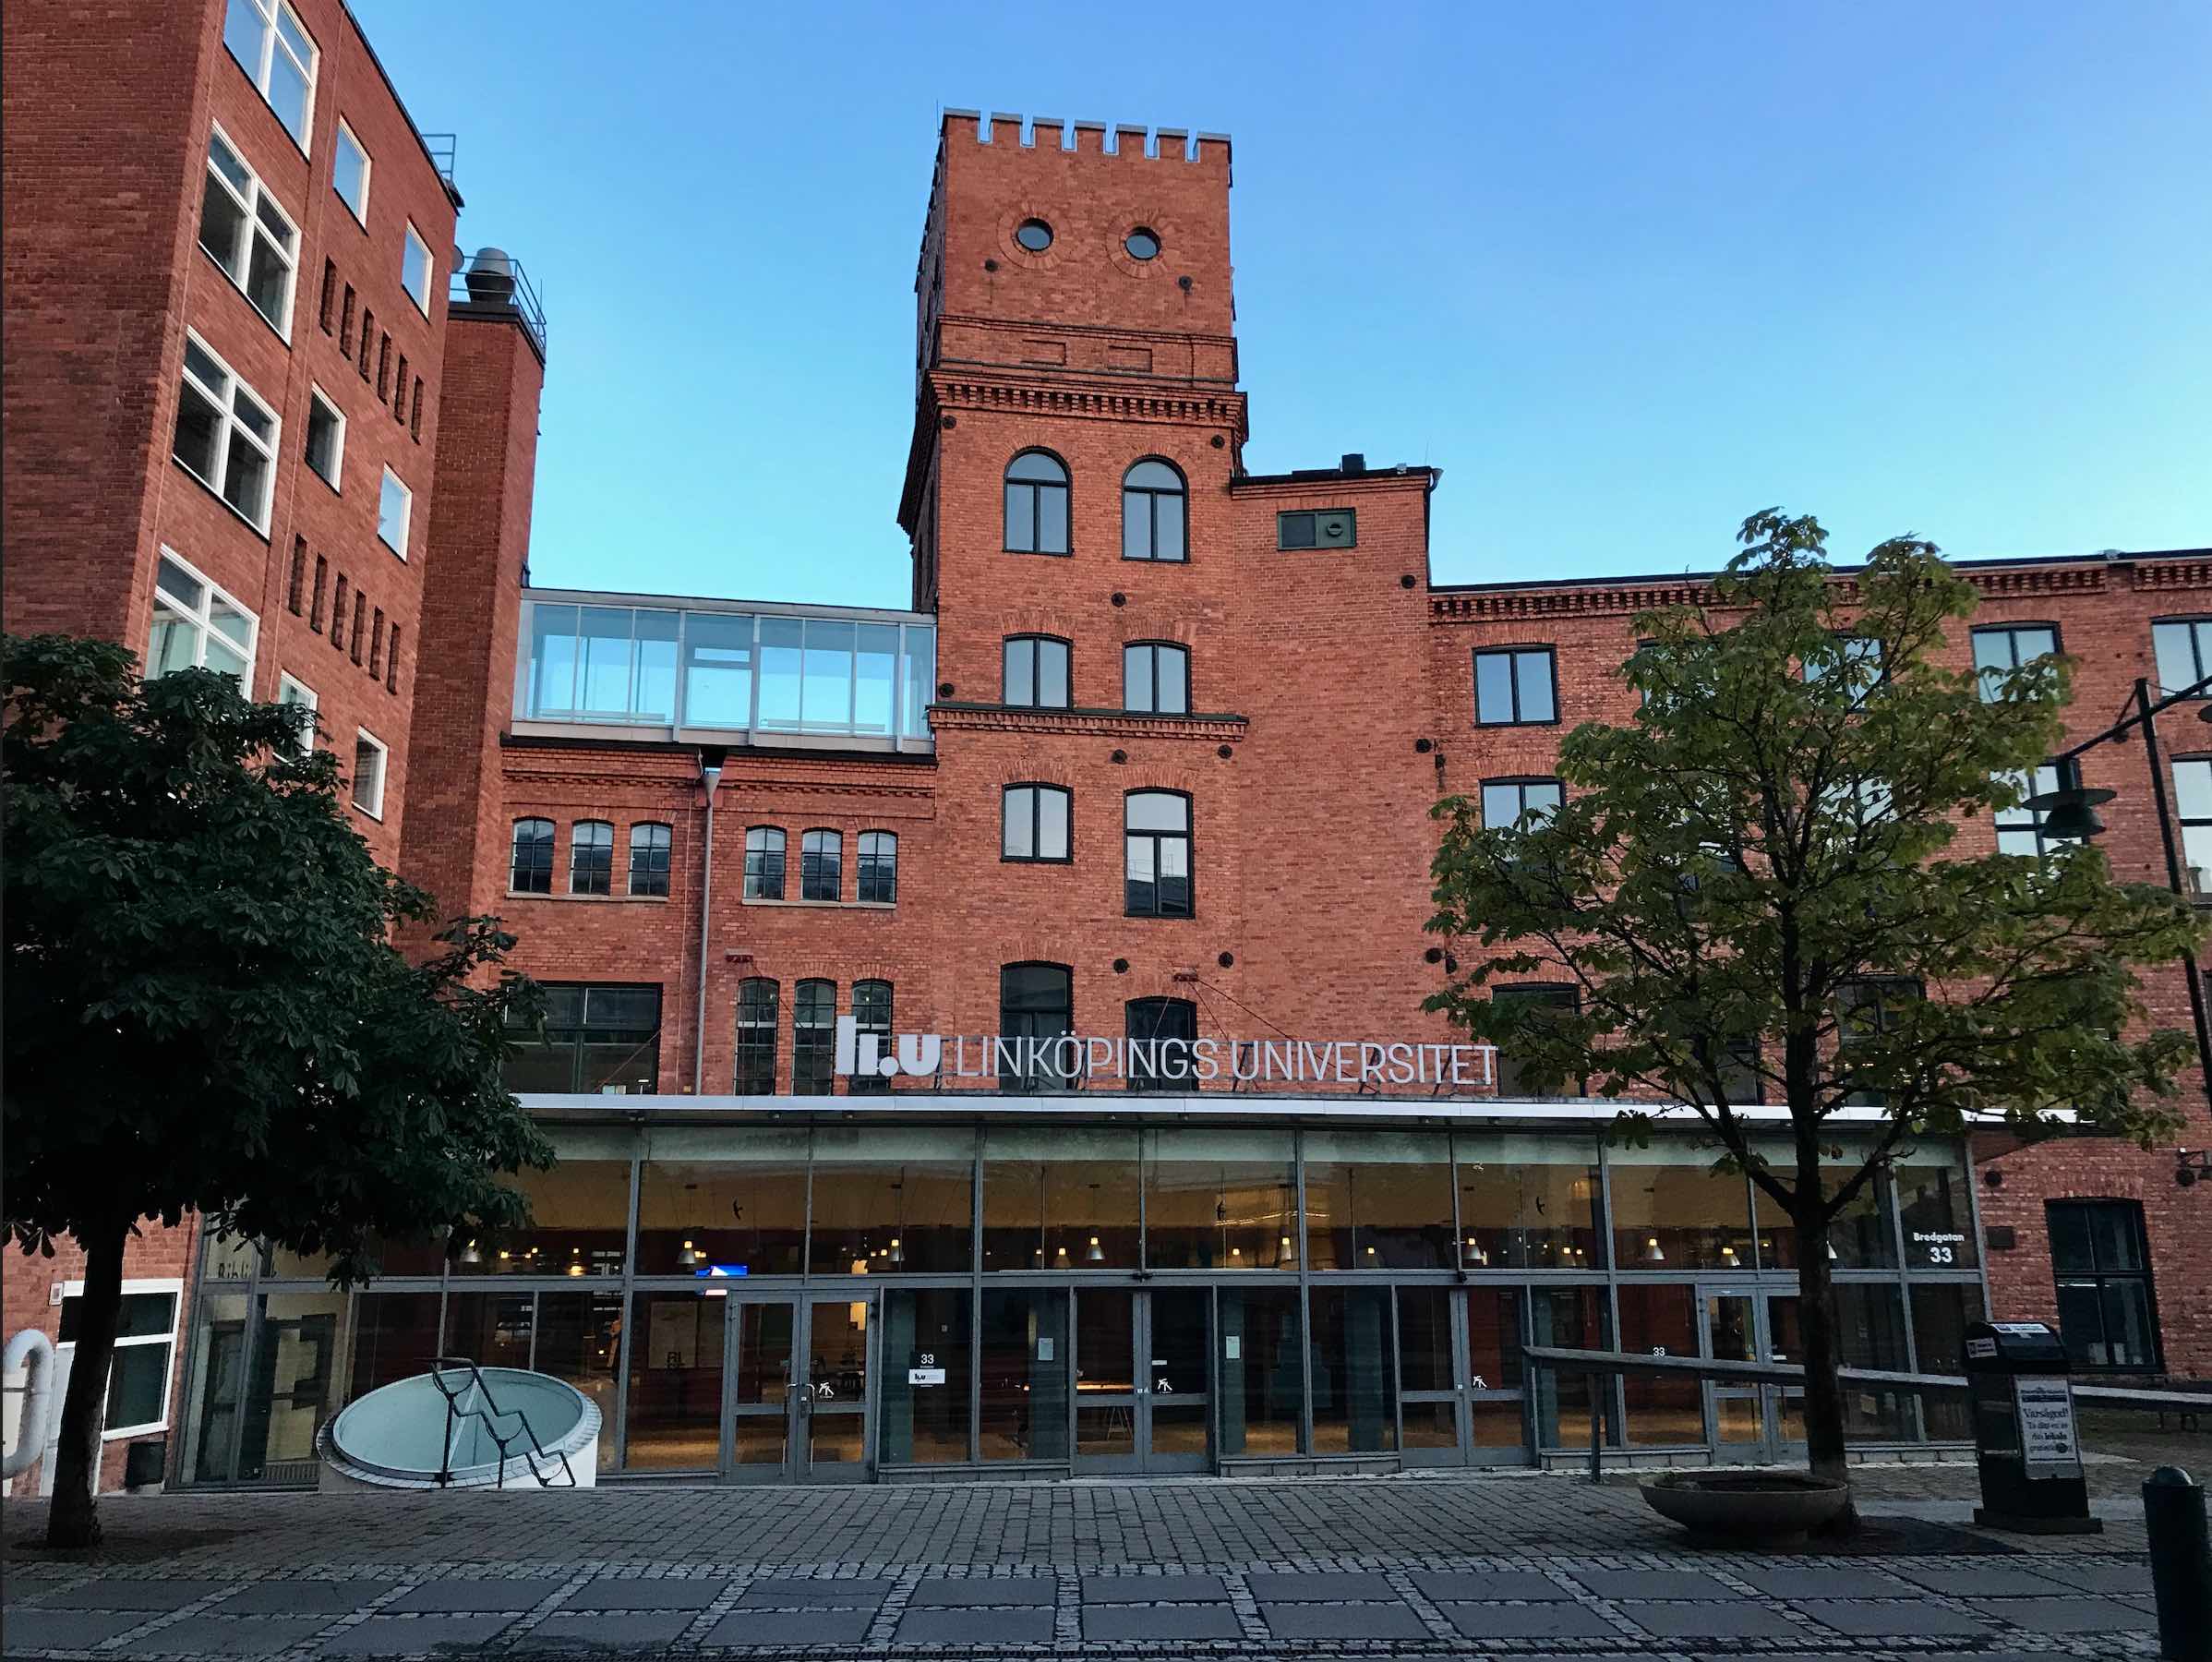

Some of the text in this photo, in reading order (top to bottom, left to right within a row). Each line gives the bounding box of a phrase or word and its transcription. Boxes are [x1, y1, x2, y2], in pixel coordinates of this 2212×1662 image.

[956, 1030, 1499, 1086] LINKÖPINGS UNIVERSITET
[1912, 1231, 1966, 1244] Bredgatan
[1929, 1246, 1954, 1263] 33
[1653, 1346, 1665, 1356] 33
[920, 1354, 934, 1364] 33
